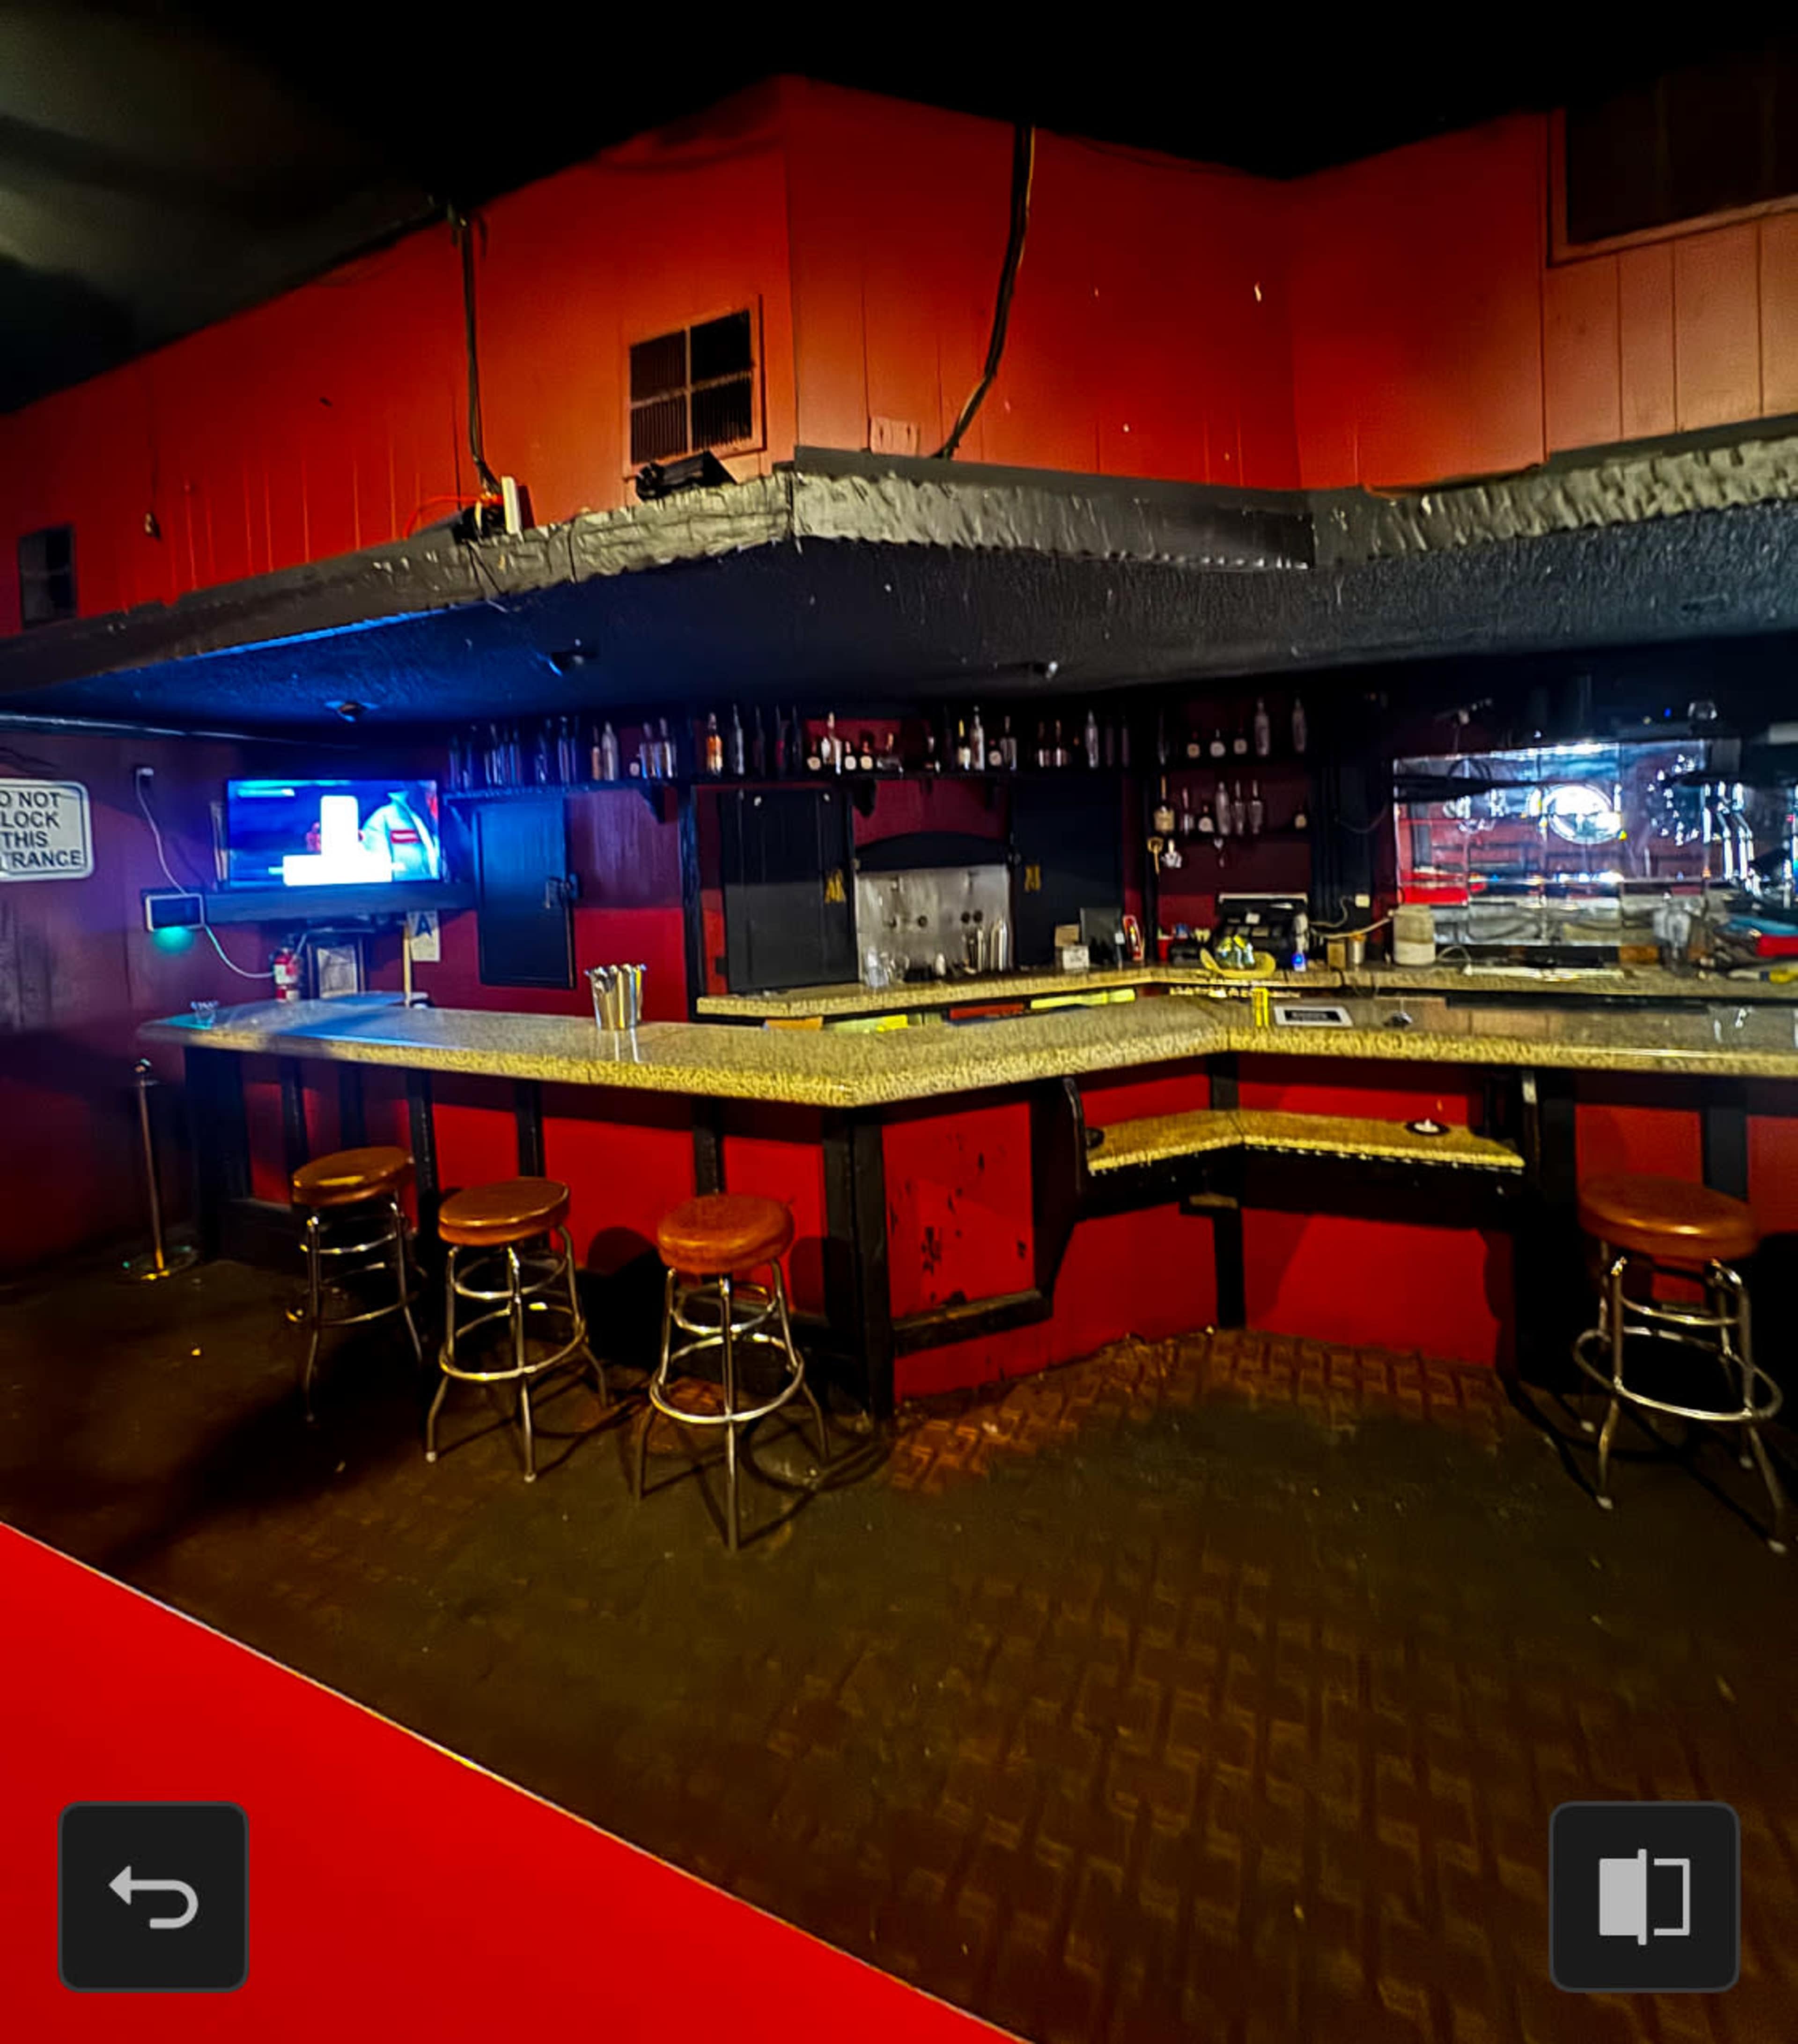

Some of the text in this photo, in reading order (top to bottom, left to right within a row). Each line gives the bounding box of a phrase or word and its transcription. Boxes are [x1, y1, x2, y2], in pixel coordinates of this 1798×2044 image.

[0, 790, 59, 808] O NOT
[0, 811, 60, 829] LOCK
[0, 831, 48, 848] THIS
[415, 914, 432, 937] A
